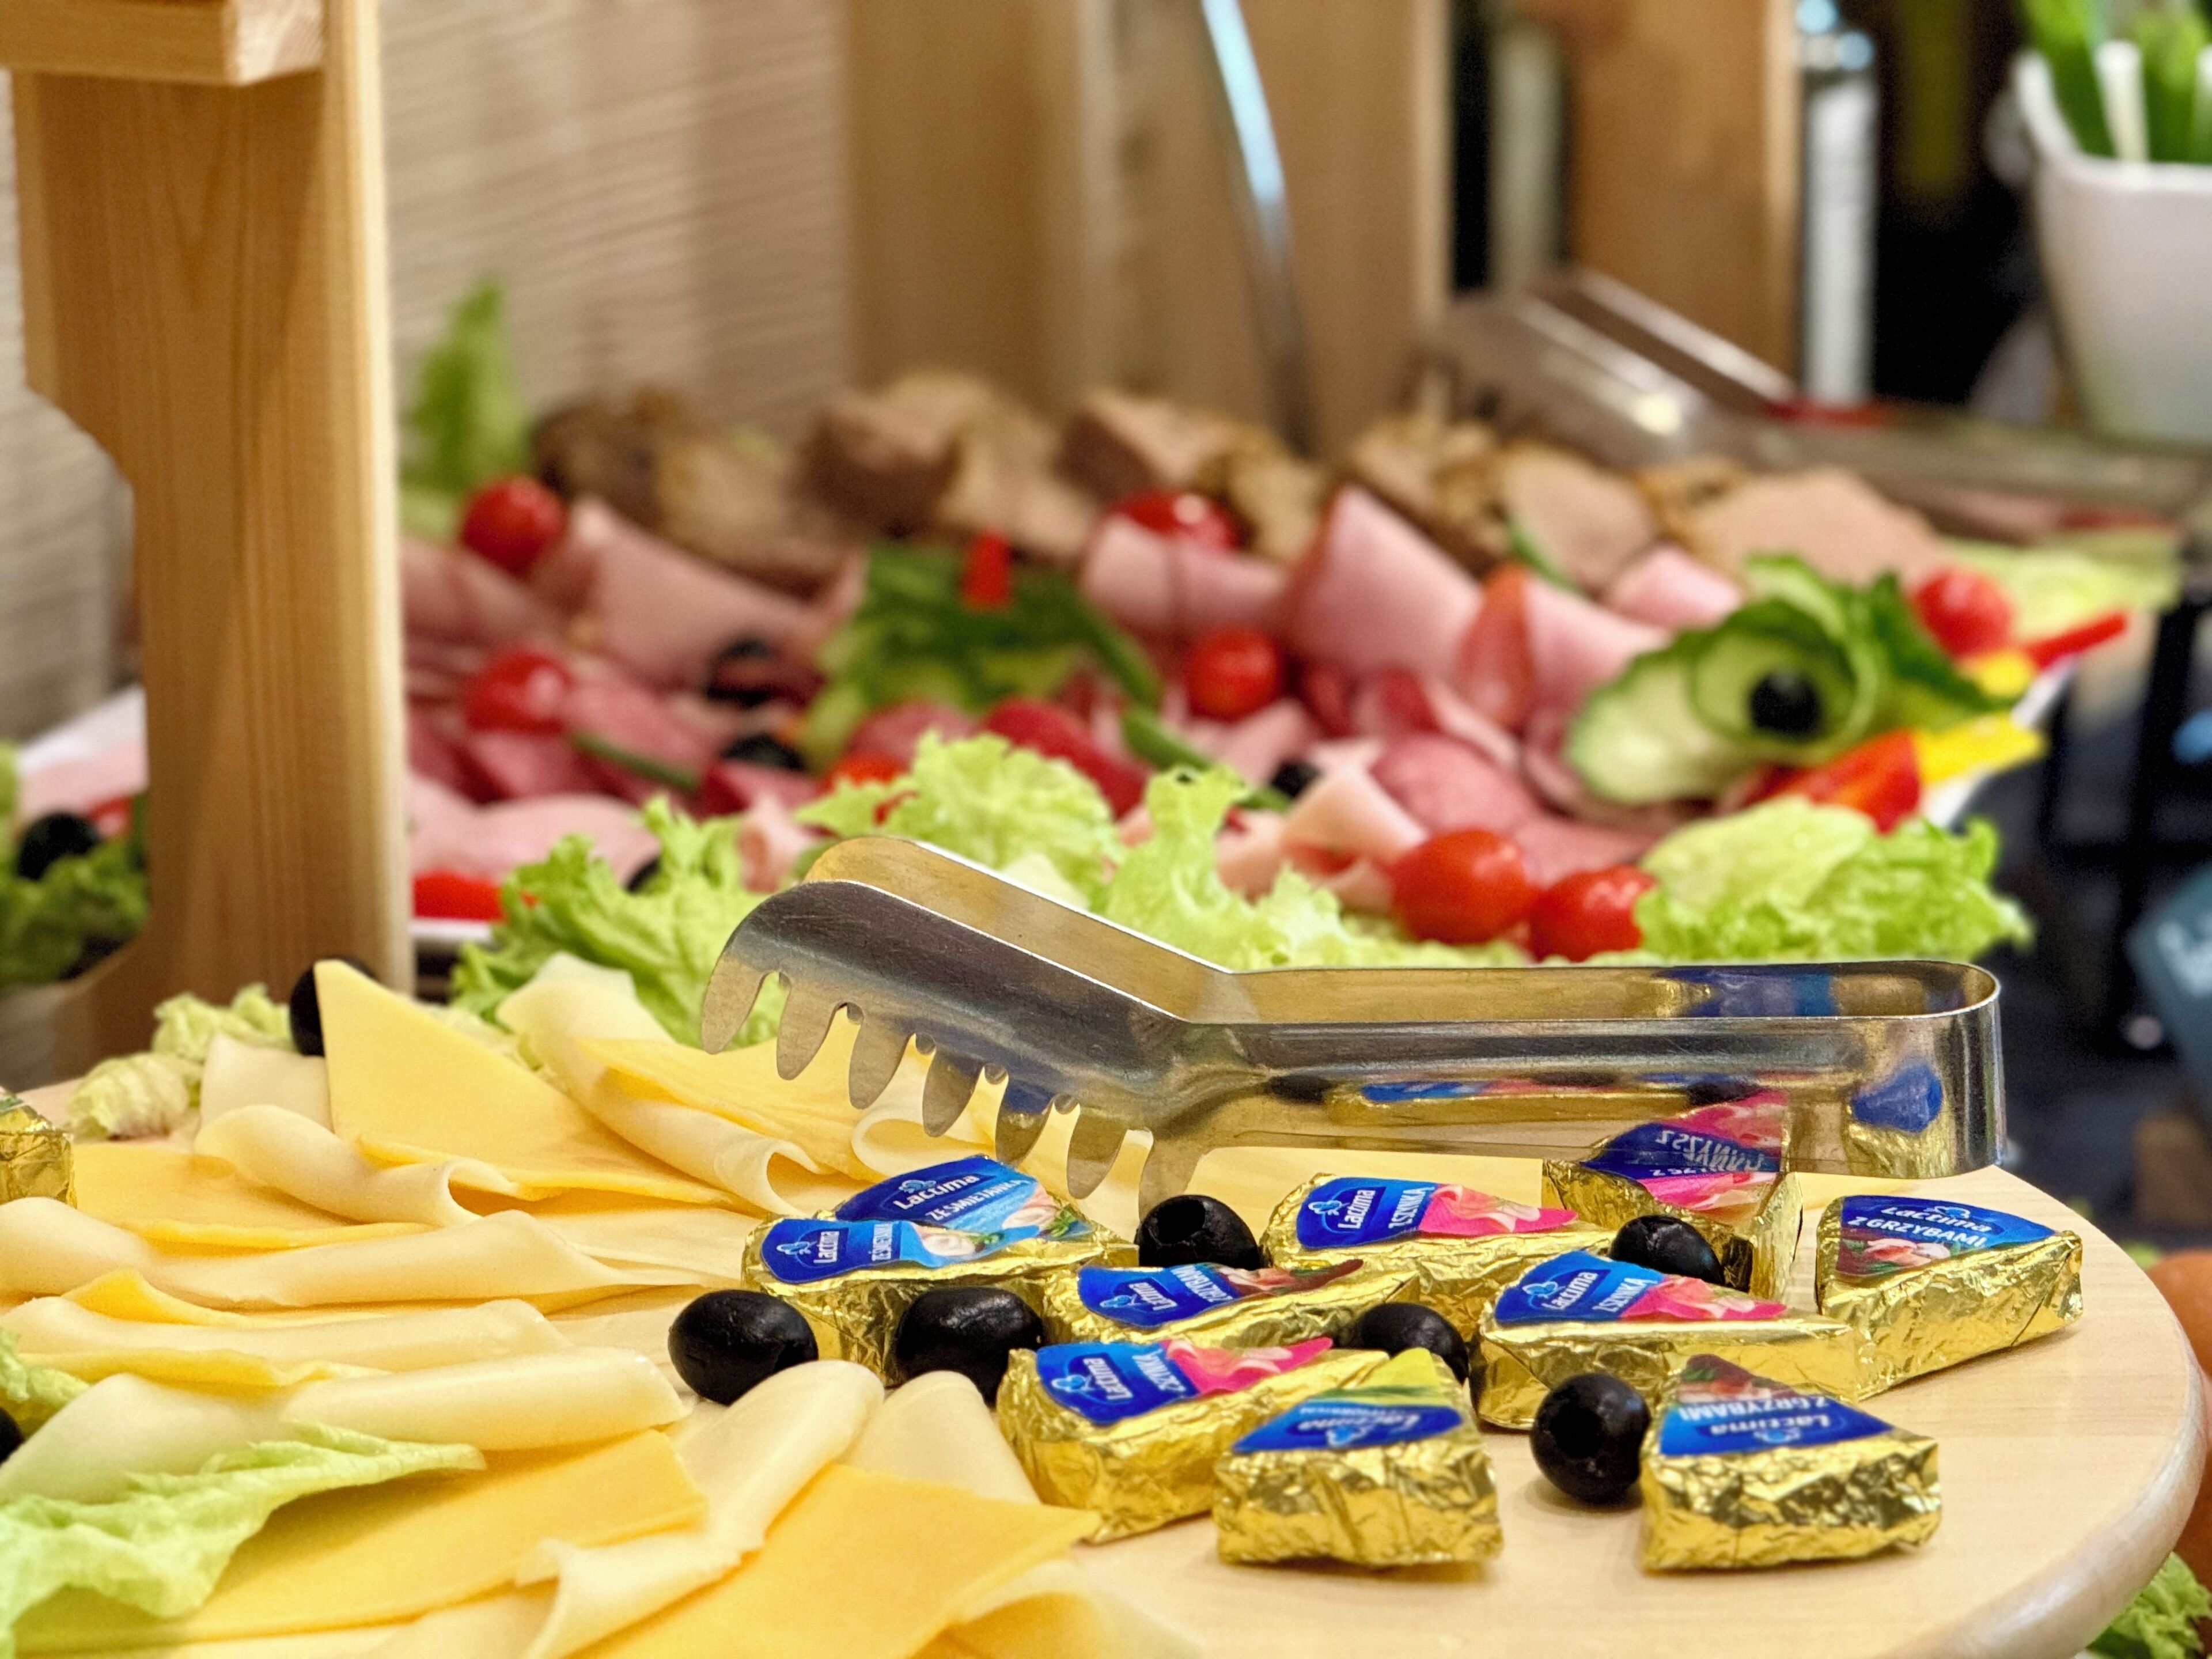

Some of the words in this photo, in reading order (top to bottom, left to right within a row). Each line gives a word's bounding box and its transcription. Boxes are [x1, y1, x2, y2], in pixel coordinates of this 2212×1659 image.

[893, 1175, 980, 1210] Lactima
[1338, 1190, 1376, 1229] Lactima
[1881, 1207, 1992, 1232] Lactima
[813, 1231, 839, 1263] Lactima
[1847, 1216, 1868, 1226] Z
[1866, 1219, 1987, 1247] GRZYBAMI
[1129, 1282, 1177, 1310] Lactima
[1541, 1272, 1599, 1310] Lactima
[1082, 1357, 1133, 1400] Lactima
[1679, 1397, 1810, 1421] GRZYBAMI
[1710, 1414, 1830, 1435] Lactima
